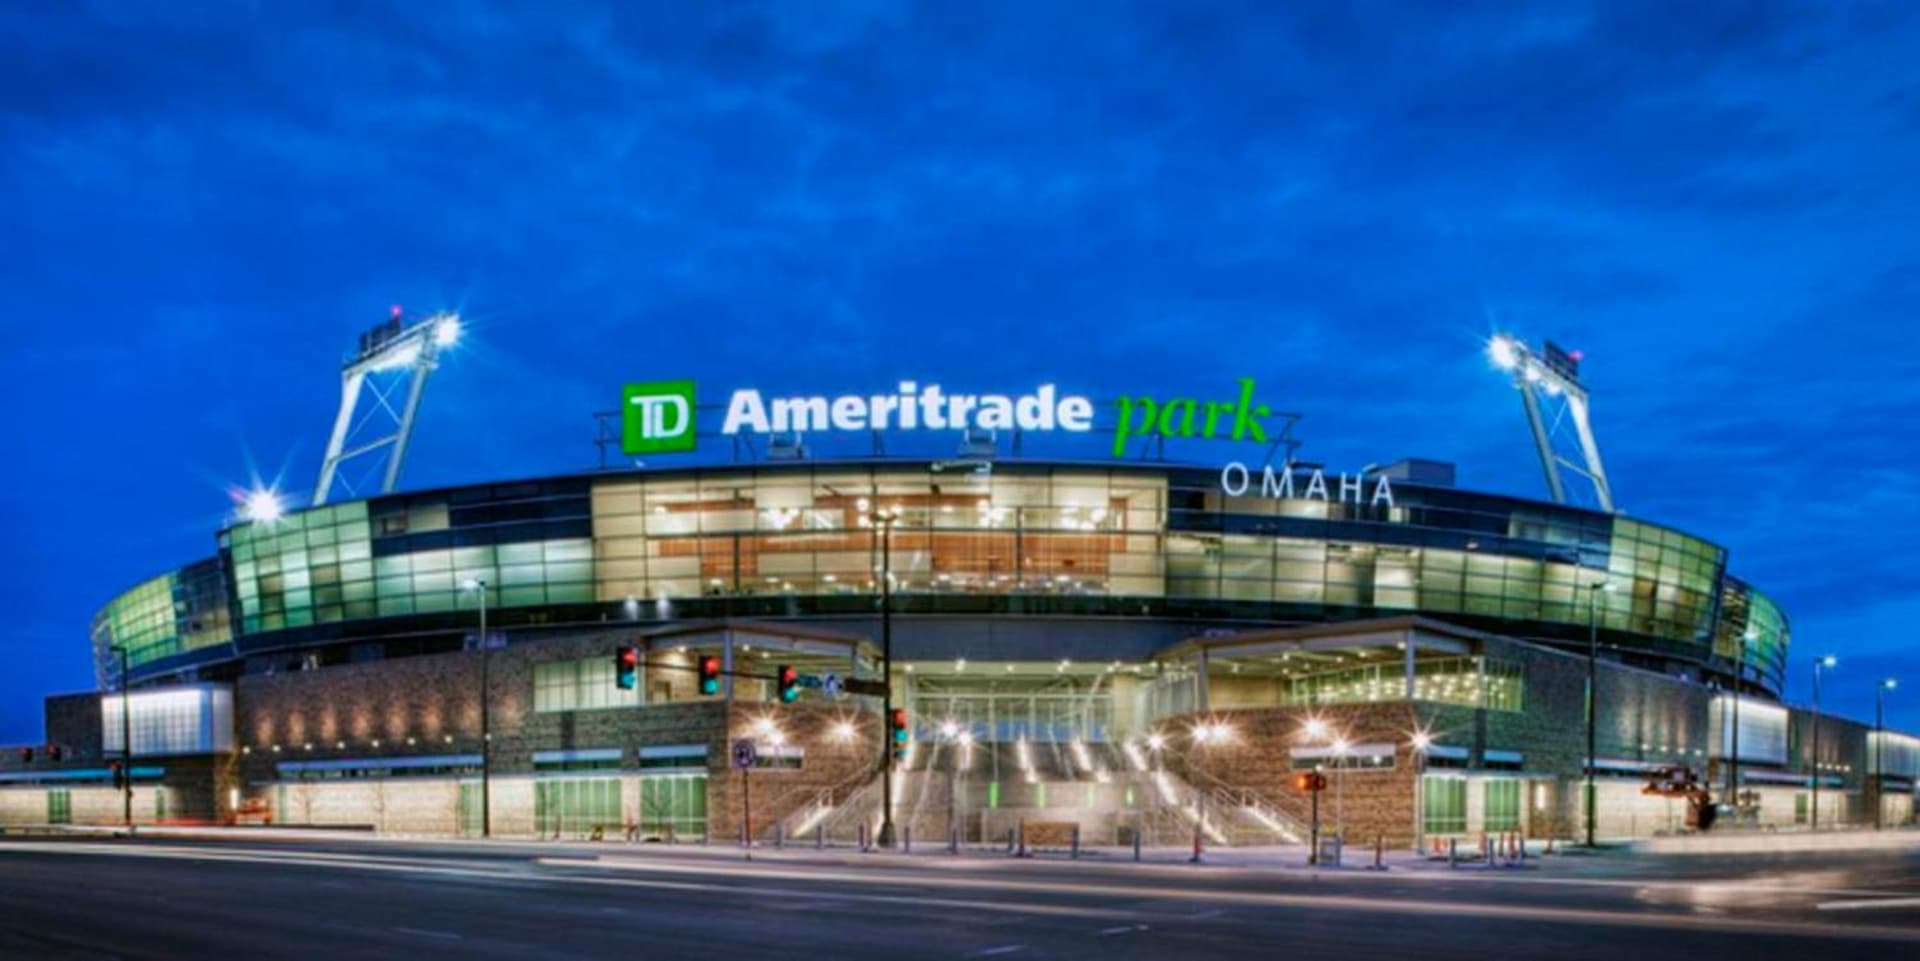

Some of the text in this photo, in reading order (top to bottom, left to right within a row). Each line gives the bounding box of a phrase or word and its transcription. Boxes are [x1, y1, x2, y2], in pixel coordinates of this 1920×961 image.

[629, 376, 1270, 457] TD Ameritrade park
[1222, 462, 1396, 506] OMAHA
